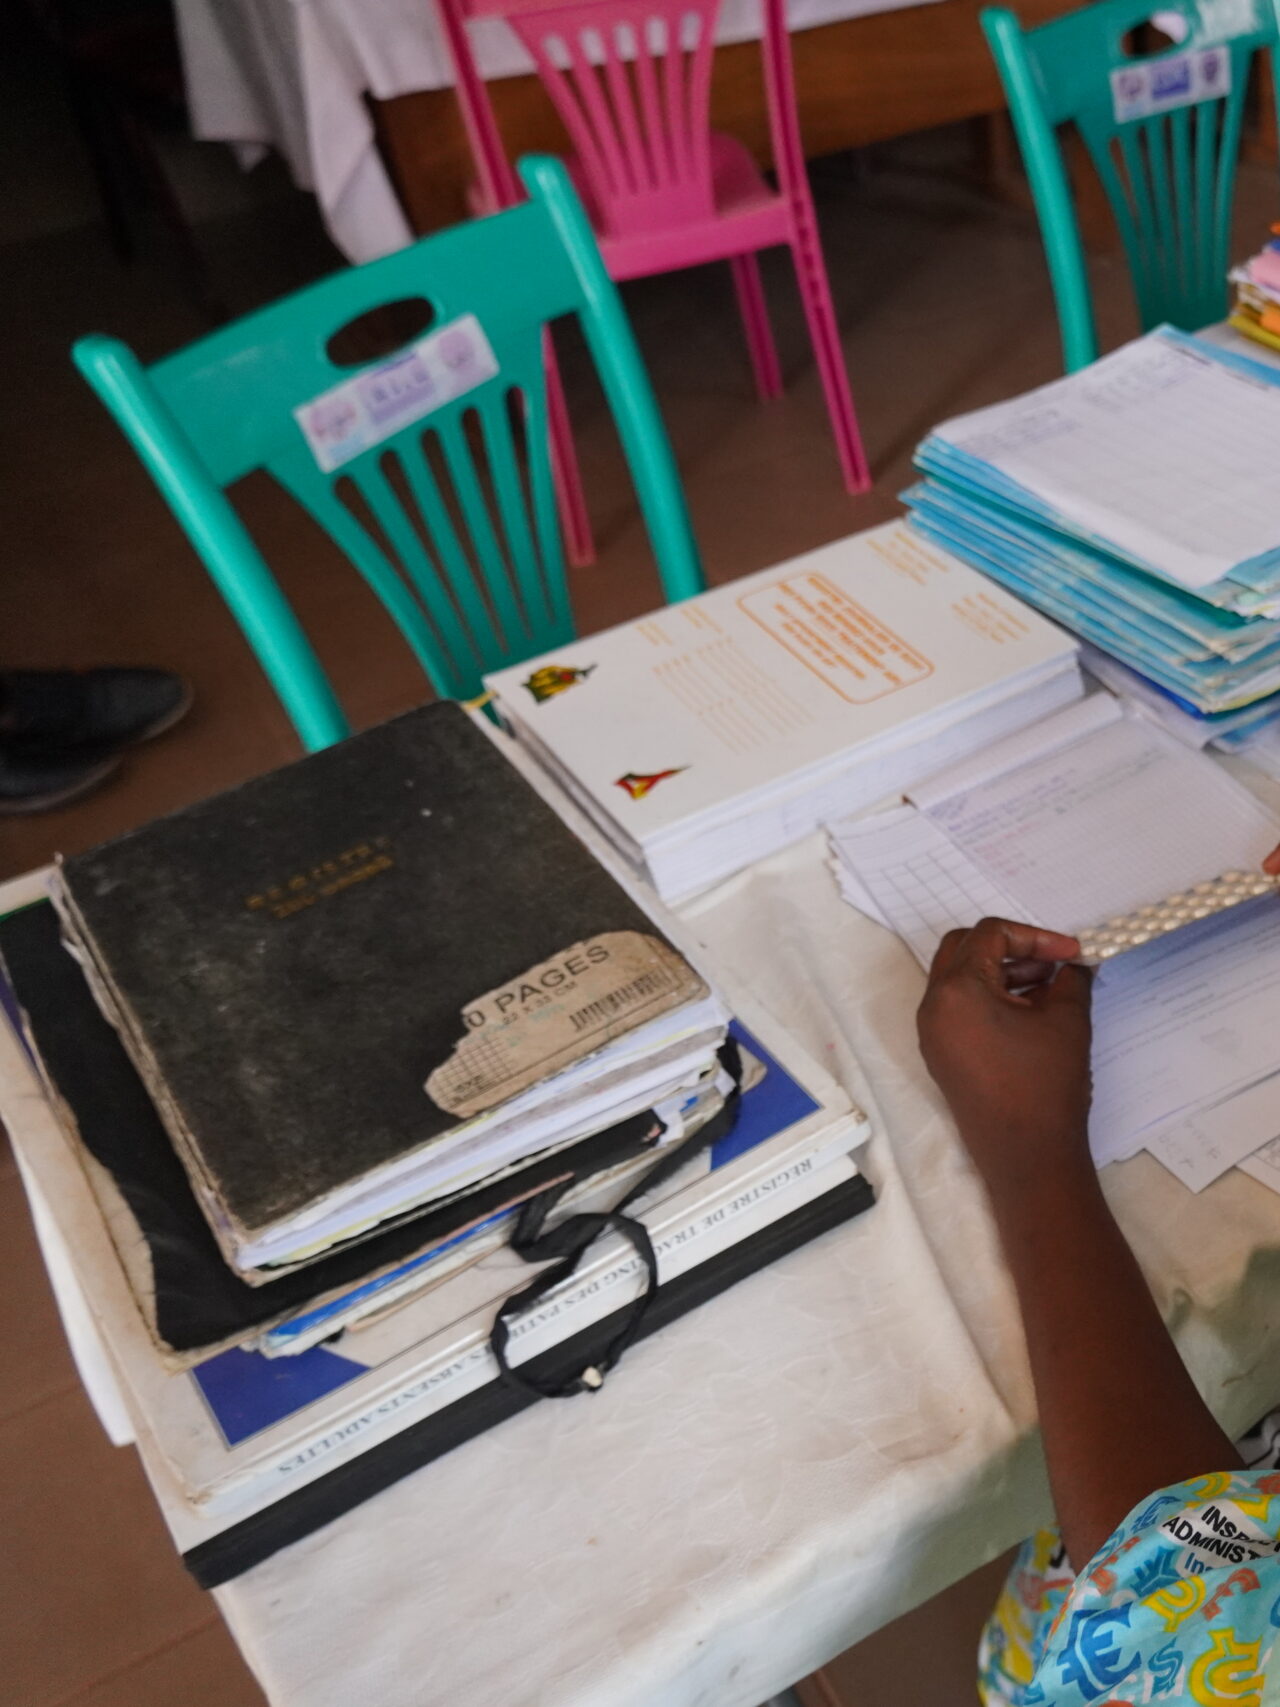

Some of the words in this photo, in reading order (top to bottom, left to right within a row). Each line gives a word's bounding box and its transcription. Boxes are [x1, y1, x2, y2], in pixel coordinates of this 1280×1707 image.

[495, 945, 610, 1013] PAGES
[726, 1159, 813, 1215] REGISTRE
[701, 1208, 725, 1228] DE
[603, 1226, 697, 1283] TRACING
[563, 1282, 599, 1307] DES
[469, 1306, 561, 1362] PATIETS
[377, 1356, 470, 1416] ABSENTS
[277, 1412, 373, 1475] ADULTES
